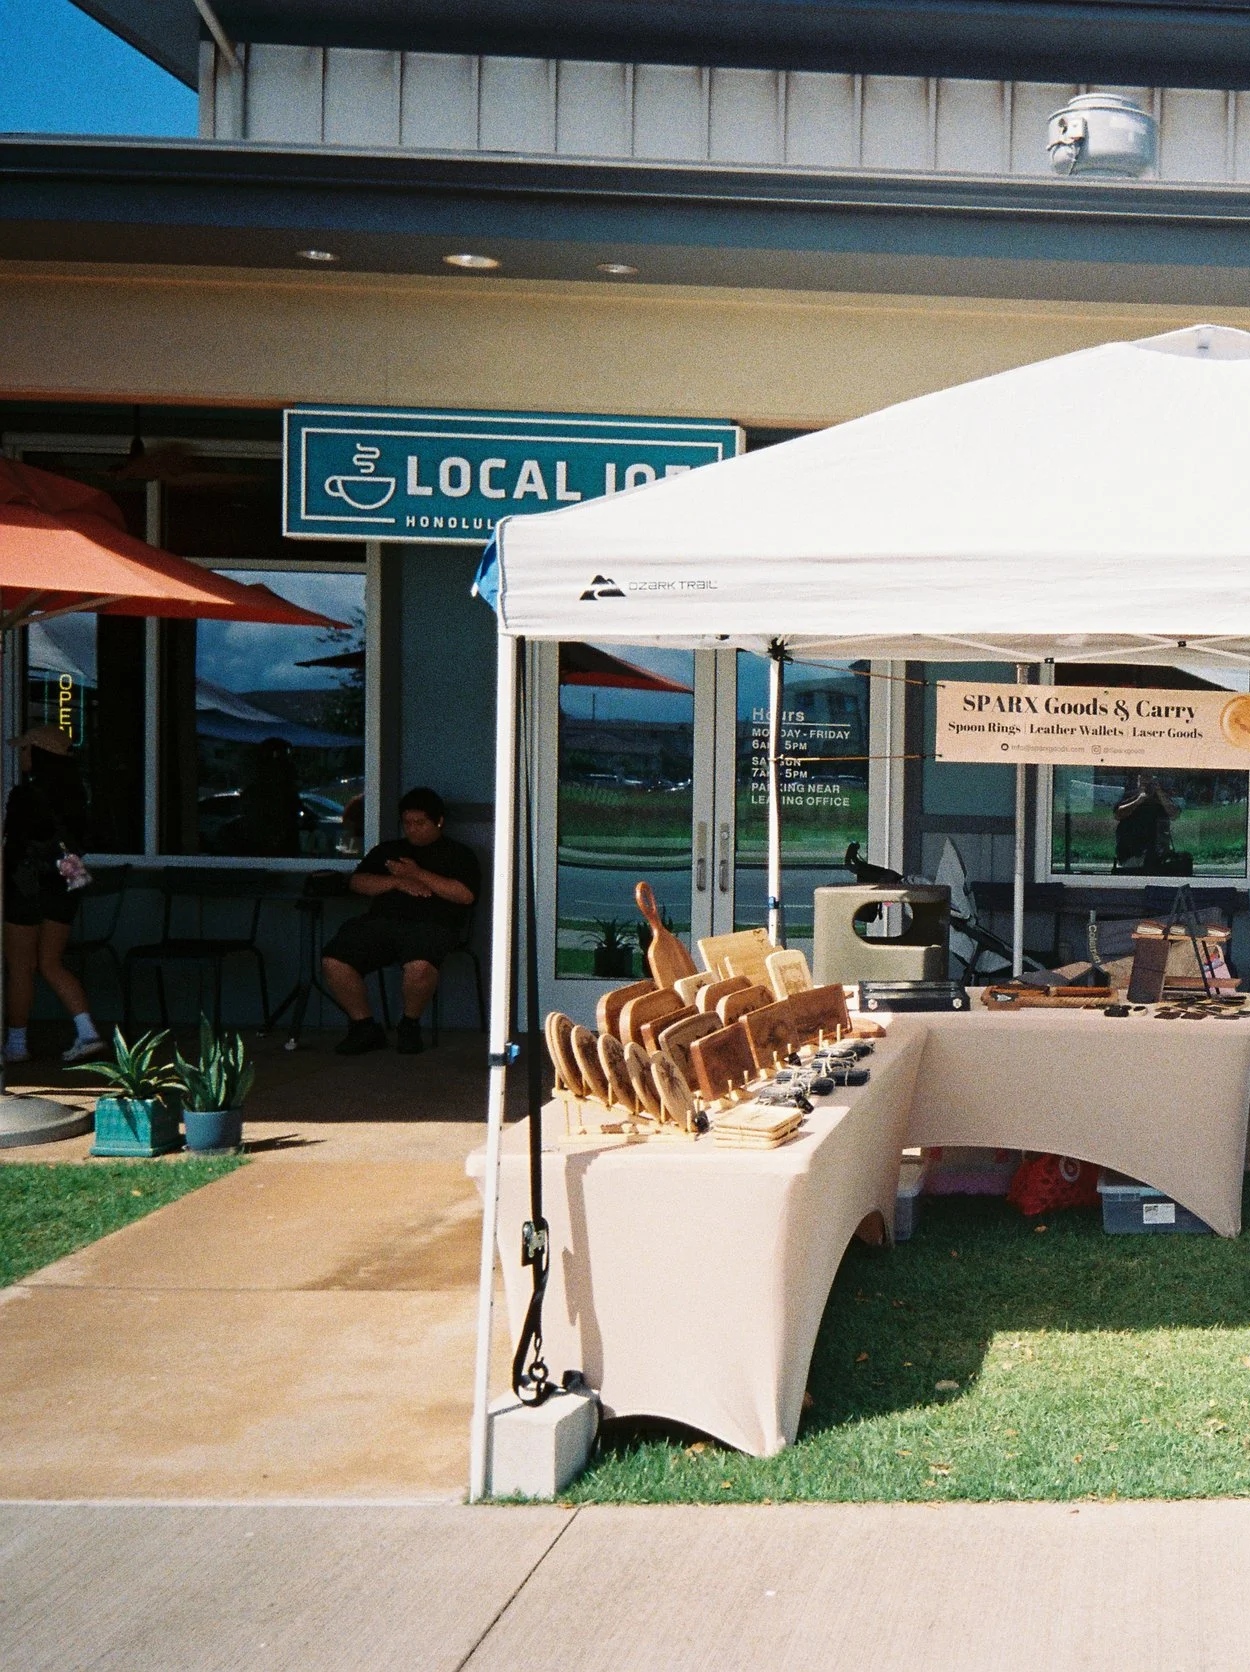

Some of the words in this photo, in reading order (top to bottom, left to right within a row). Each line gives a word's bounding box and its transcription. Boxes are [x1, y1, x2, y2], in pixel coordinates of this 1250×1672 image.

[407, 455, 582, 500] LOCAL
[963, 694, 1038, 714] SPARX
[1044, 697, 1108, 716] Goods
[1113, 699, 1130, 721] &
[1136, 699, 1195, 724] Carry
[810, 730, 850, 740] FRIDAY
[948, 721, 985, 734] Spoon
[988, 722, 1021, 735] Rings
[1030, 724, 1077, 735] Leather
[1079, 725, 1124, 736] Wallets
[1132, 727, 1165, 738] Laser
[1167, 728, 1203, 739] Goods
[785, 740, 807, 750] 5PM
[785, 768, 808, 778] 5PM
[808, 784, 840, 794] NEAR
[806, 796, 850, 807] OFFICE
